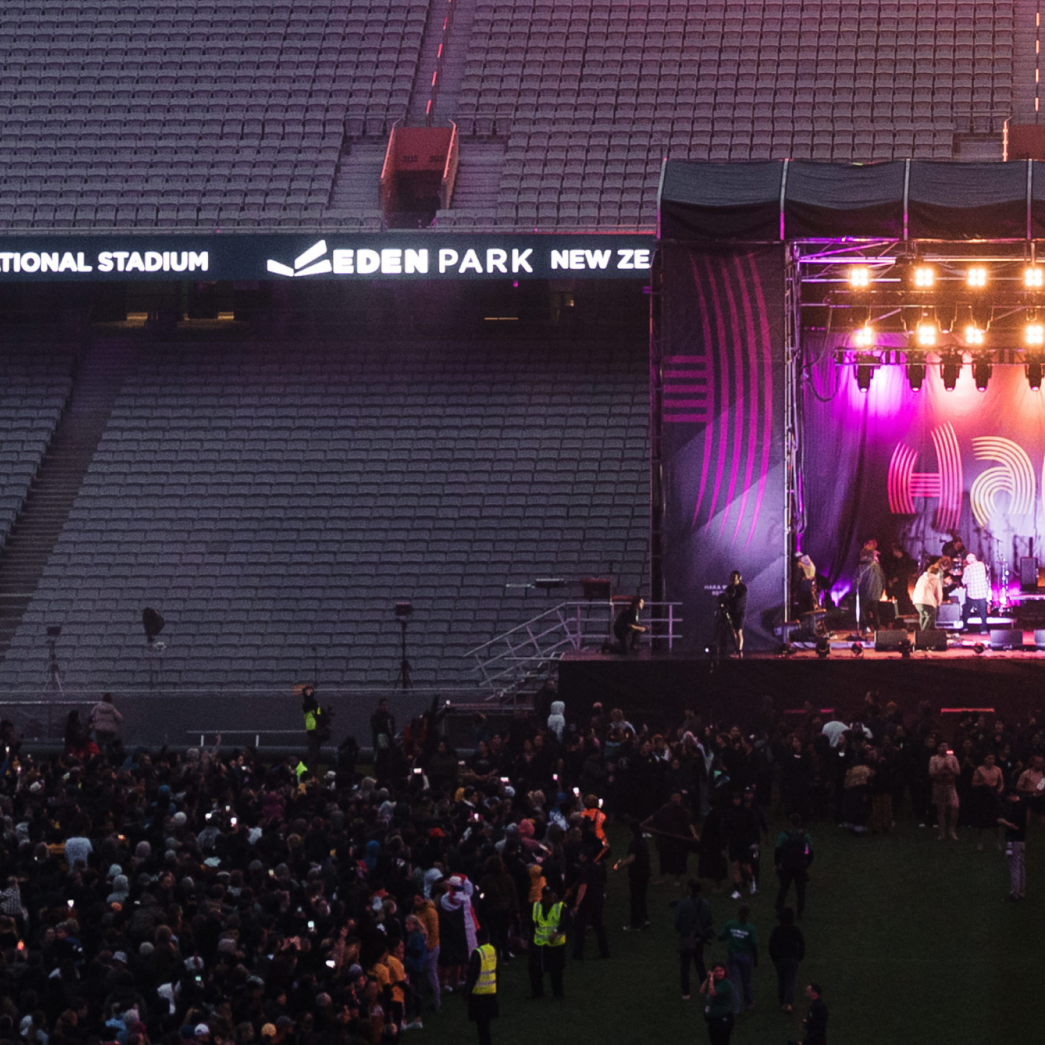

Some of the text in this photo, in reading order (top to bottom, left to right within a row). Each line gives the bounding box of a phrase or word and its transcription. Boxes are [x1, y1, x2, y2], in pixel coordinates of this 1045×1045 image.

[0, 252, 208, 272] TIONAL STADIUM
[333, 249, 532, 274] EDEN PARK
[551, 250, 651, 269] NEW ZE
